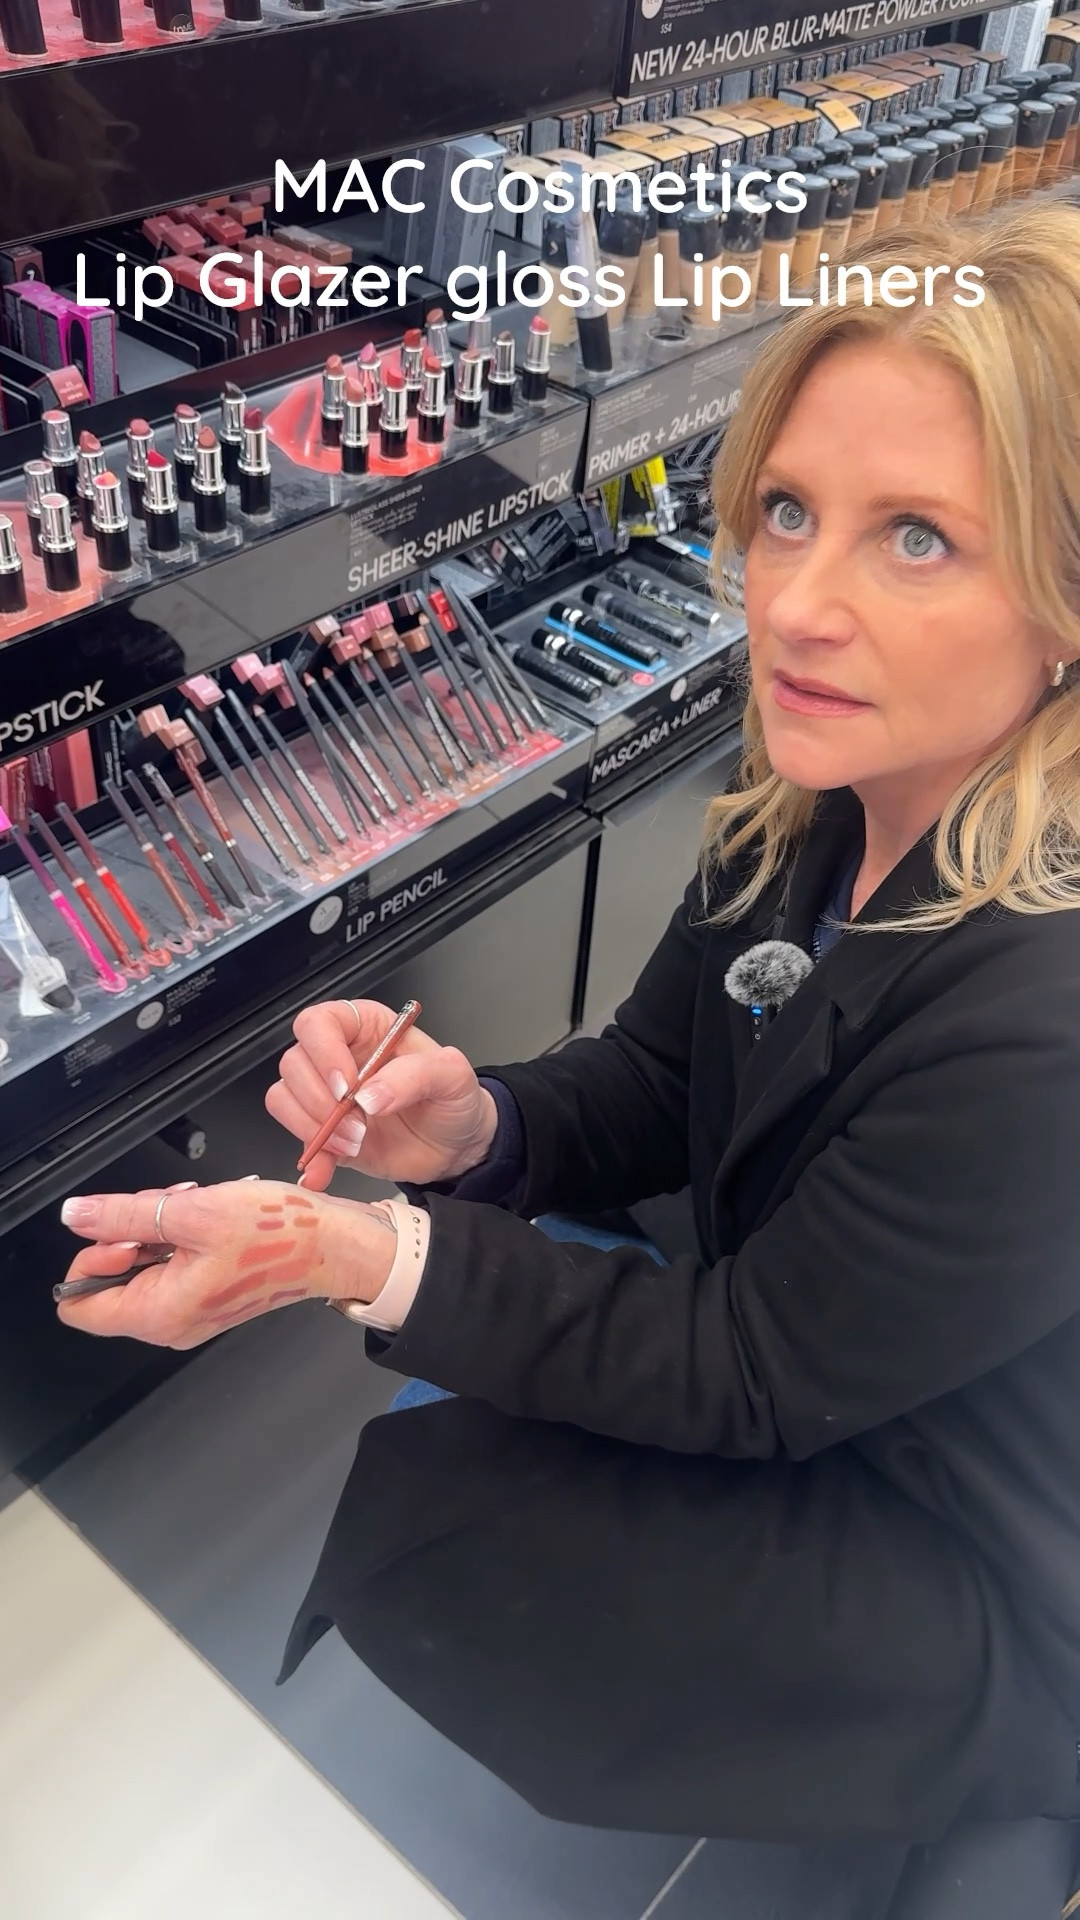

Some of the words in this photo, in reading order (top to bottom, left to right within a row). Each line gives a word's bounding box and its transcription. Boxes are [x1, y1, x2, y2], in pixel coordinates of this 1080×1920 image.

[630, 44, 682, 83] NEW
[682, 26, 769, 72] 24-HOUR
[770, 2, 875, 51] BLUR-MATTE
[588, 430, 651, 480] PRIMER
[668, 390, 742, 441] 24-HOUR
[347, 508, 485, 592] SHEER-SHINE
[488, 469, 571, 528] LIPSTICK
[591, 721, 670, 783] MASCARA
[681, 687, 722, 726] LINER
[346, 910, 376, 943] LIP
[380, 868, 448, 922] PENCIL
